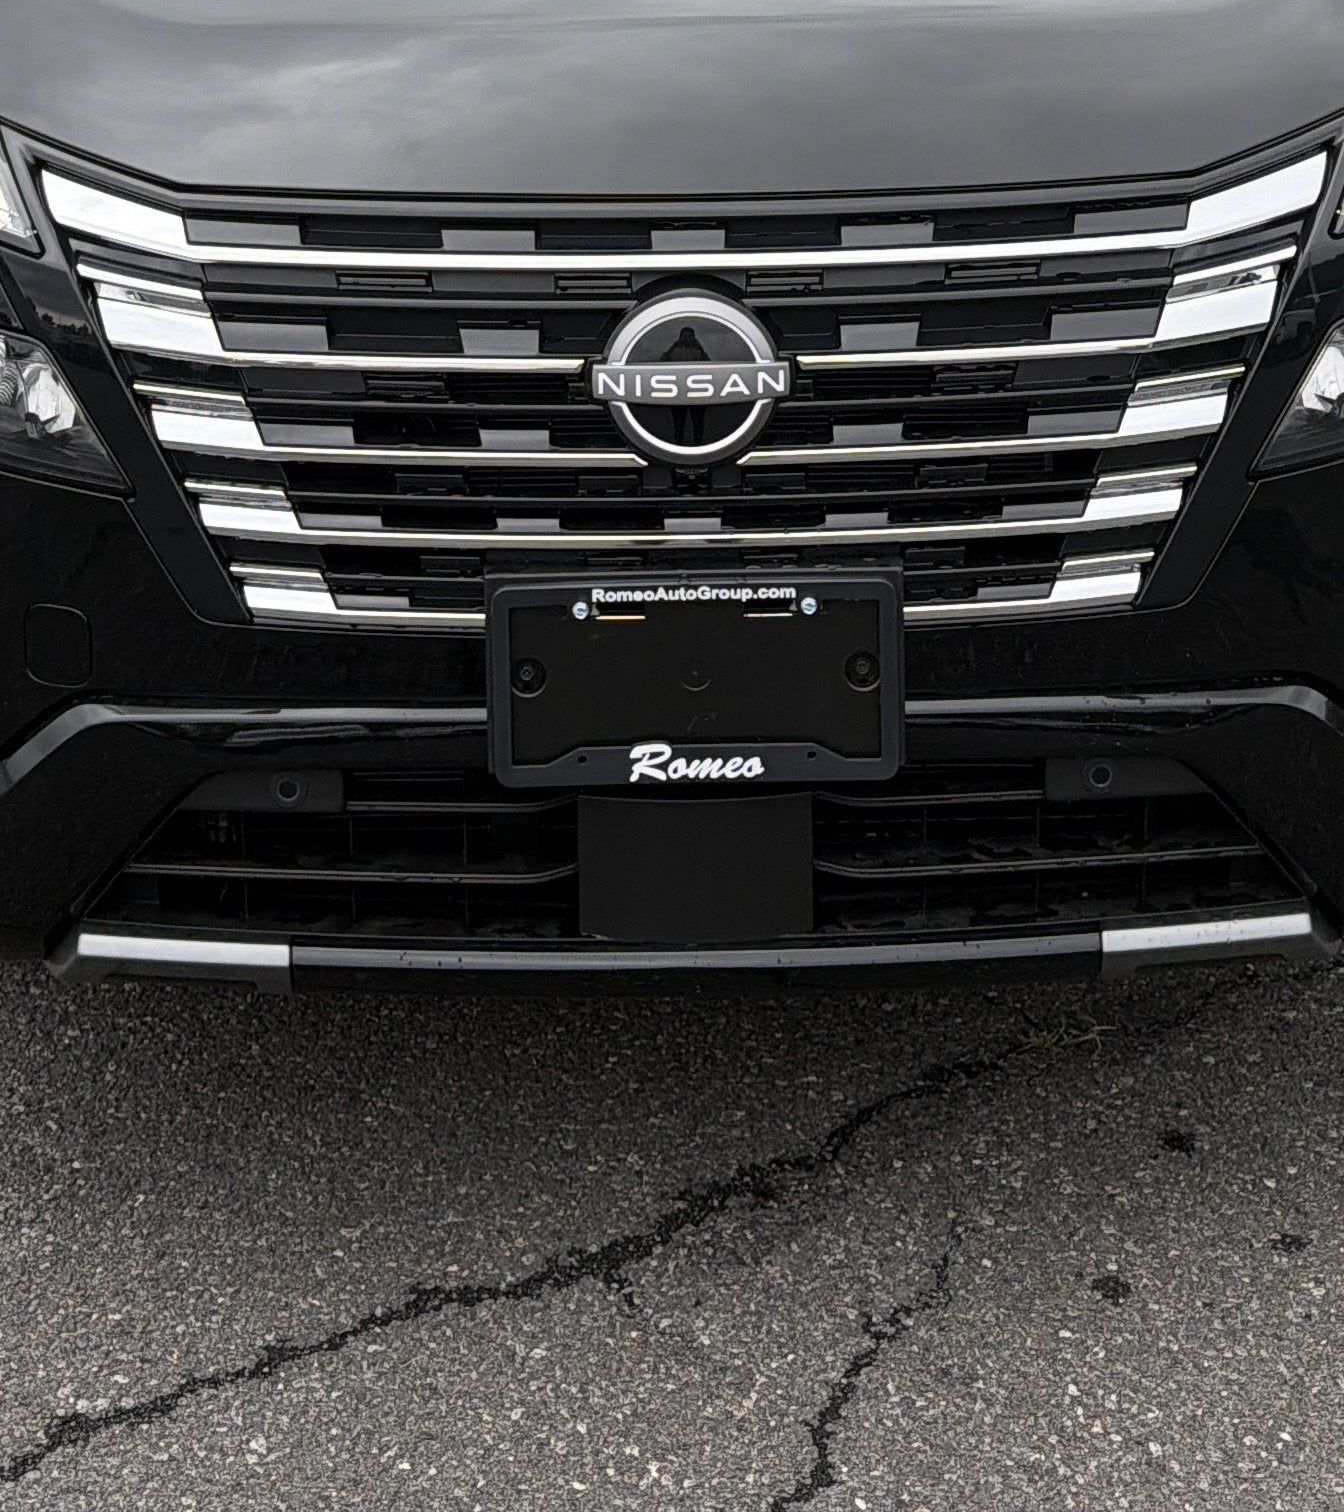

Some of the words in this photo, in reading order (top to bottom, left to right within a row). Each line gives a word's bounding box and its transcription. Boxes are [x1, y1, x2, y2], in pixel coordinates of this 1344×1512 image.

[597, 369, 785, 399] NISSAN
[591, 586, 796, 603] RomeoAutoGroup.com
[629, 742, 765, 783] Romeo
